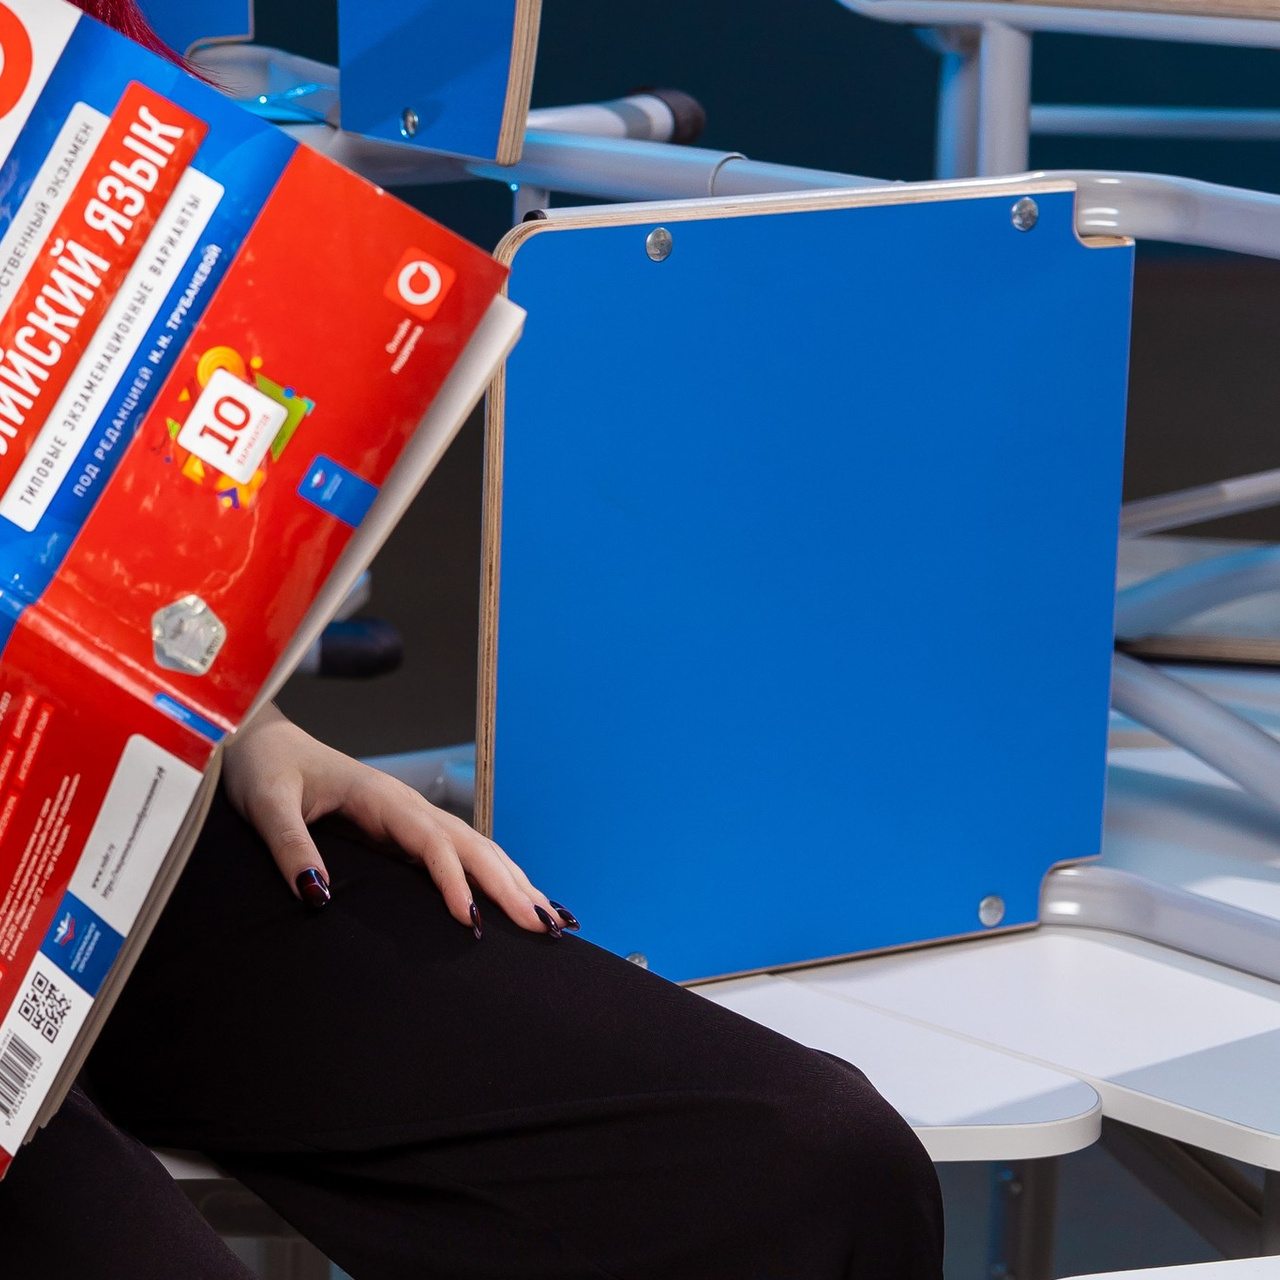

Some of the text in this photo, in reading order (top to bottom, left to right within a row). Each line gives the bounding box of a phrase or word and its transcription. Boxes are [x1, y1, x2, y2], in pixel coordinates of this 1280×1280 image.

[44, 121, 96, 201] ЭКЗАМЕН
[77, 103, 187, 246] ЯЗЫК
[20, 199, 199, 504] ТИПОВЫЕ ЭКЗАМЕНАЦИОННЫЕ ВАРИАНТЫ
[70, 460, 101, 499] ПОД
[92, 363, 155, 462] РЕДАКЦИЕЙ
[165, 240, 223, 331] ТРУБАНЕВОЙ
[196, 390, 256, 455] 10
